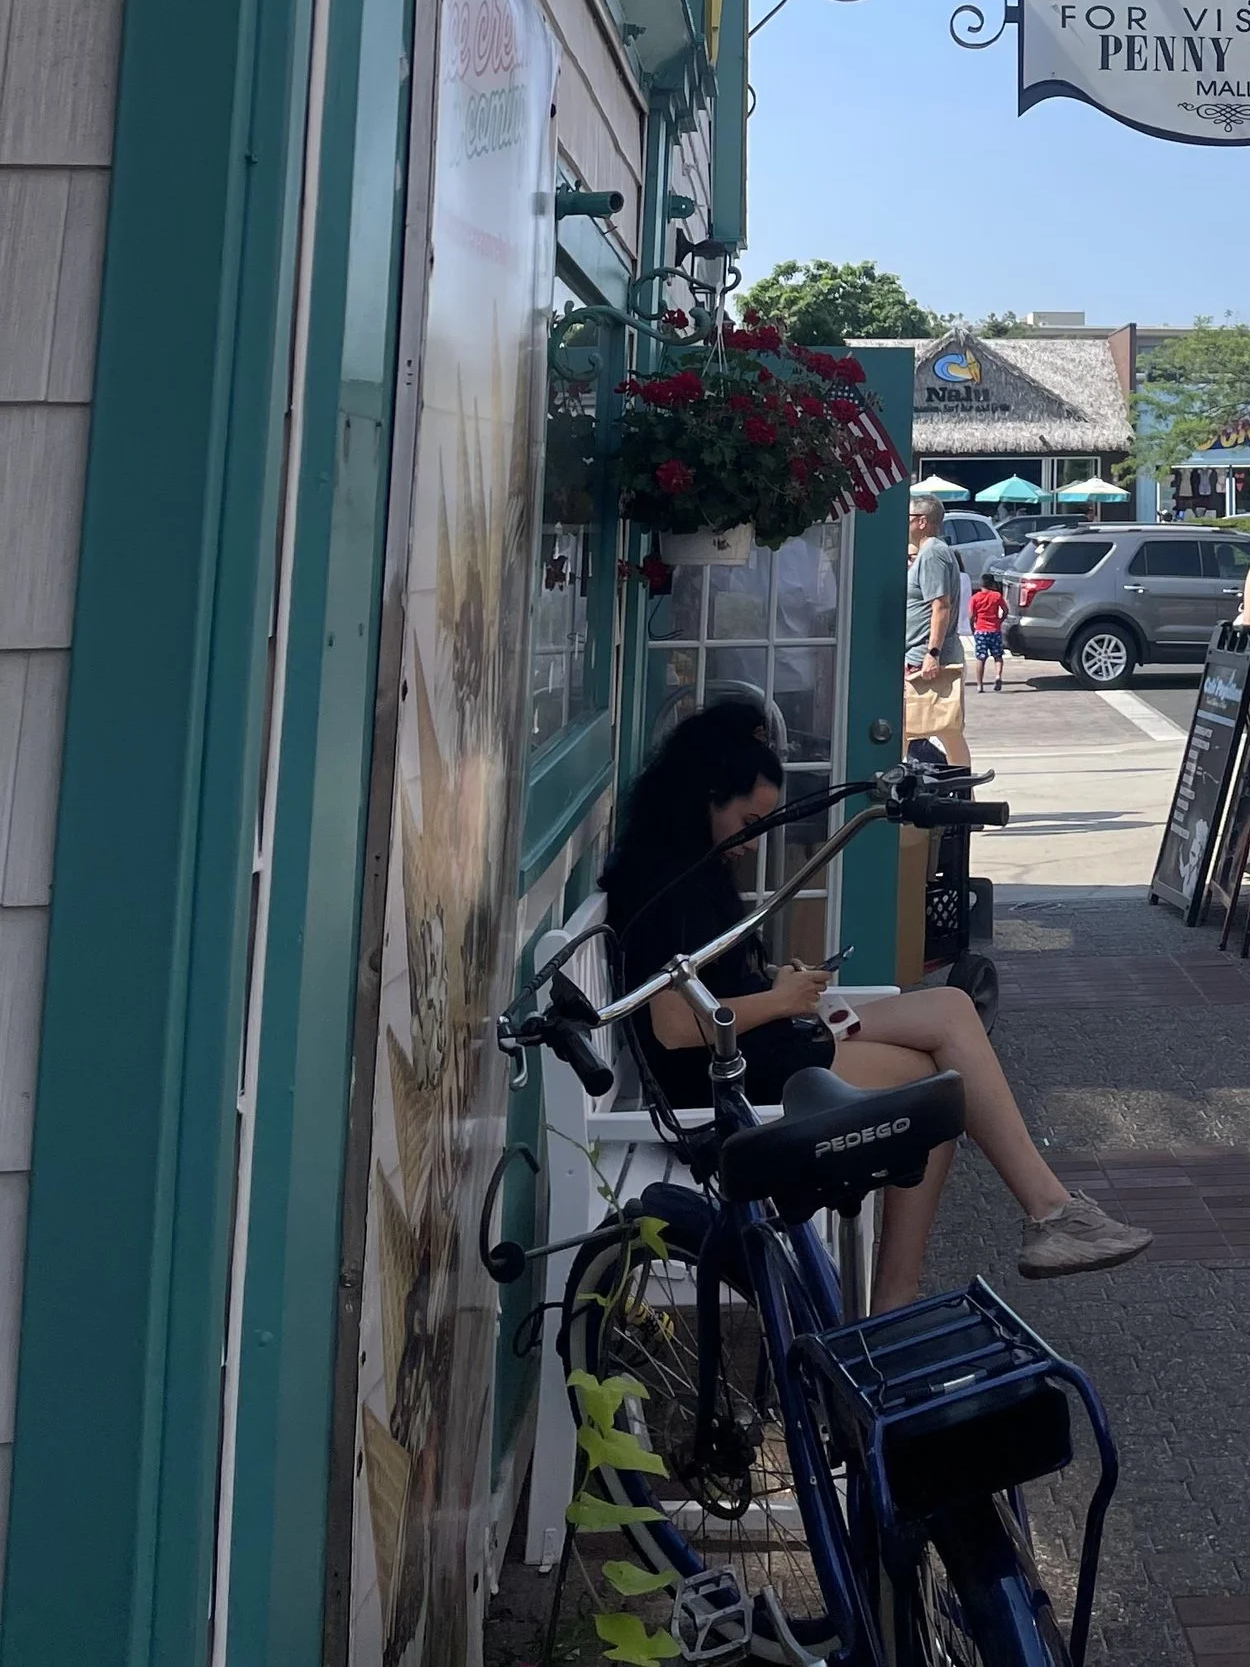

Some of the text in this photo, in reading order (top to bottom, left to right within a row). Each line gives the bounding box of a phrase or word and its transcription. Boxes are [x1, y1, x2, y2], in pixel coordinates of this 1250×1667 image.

[1060, 4, 1148, 31] FOR
[1098, 33, 1231, 72] PENNY
[925, 385, 990, 402] Nalu
[814, 1117, 911, 1159] PEDEGO
